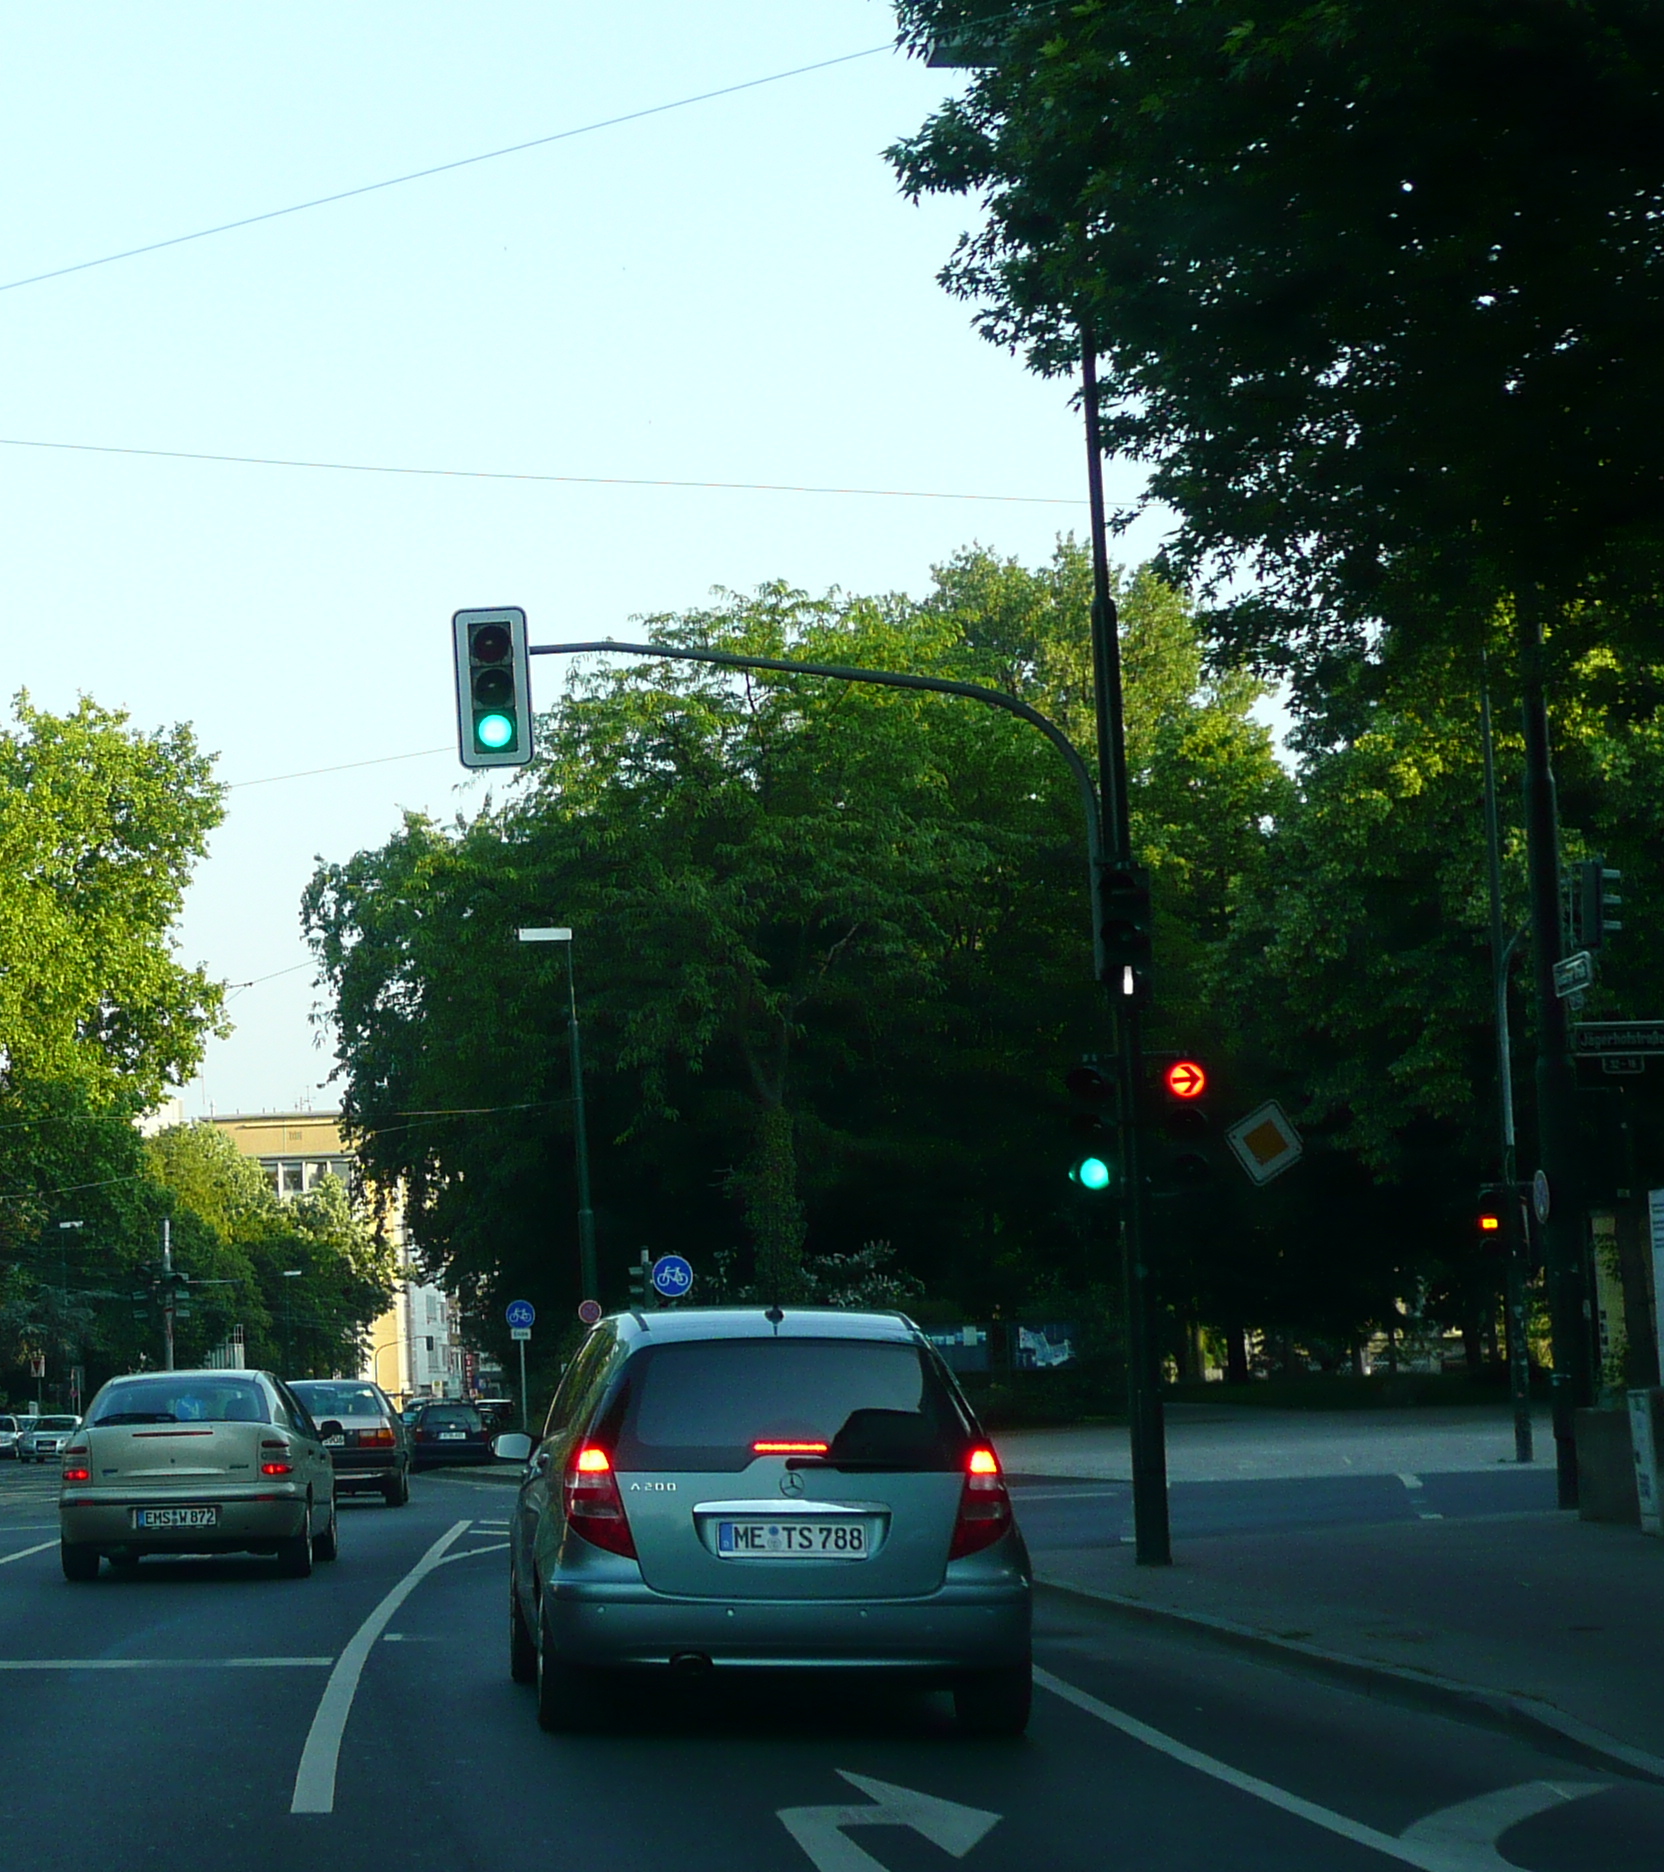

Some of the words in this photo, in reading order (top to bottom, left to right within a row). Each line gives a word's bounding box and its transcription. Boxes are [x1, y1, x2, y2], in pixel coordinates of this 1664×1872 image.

[644, 1482, 677, 1491] 200
[145, 1511, 171, 1525] EMS
[179, 1511, 188, 1523] W
[190, 1510, 214, 1523] 872
[733, 1526, 766, 1549] ME
[781, 1526, 813, 1549] TS
[818, 1527, 863, 1550] 788
